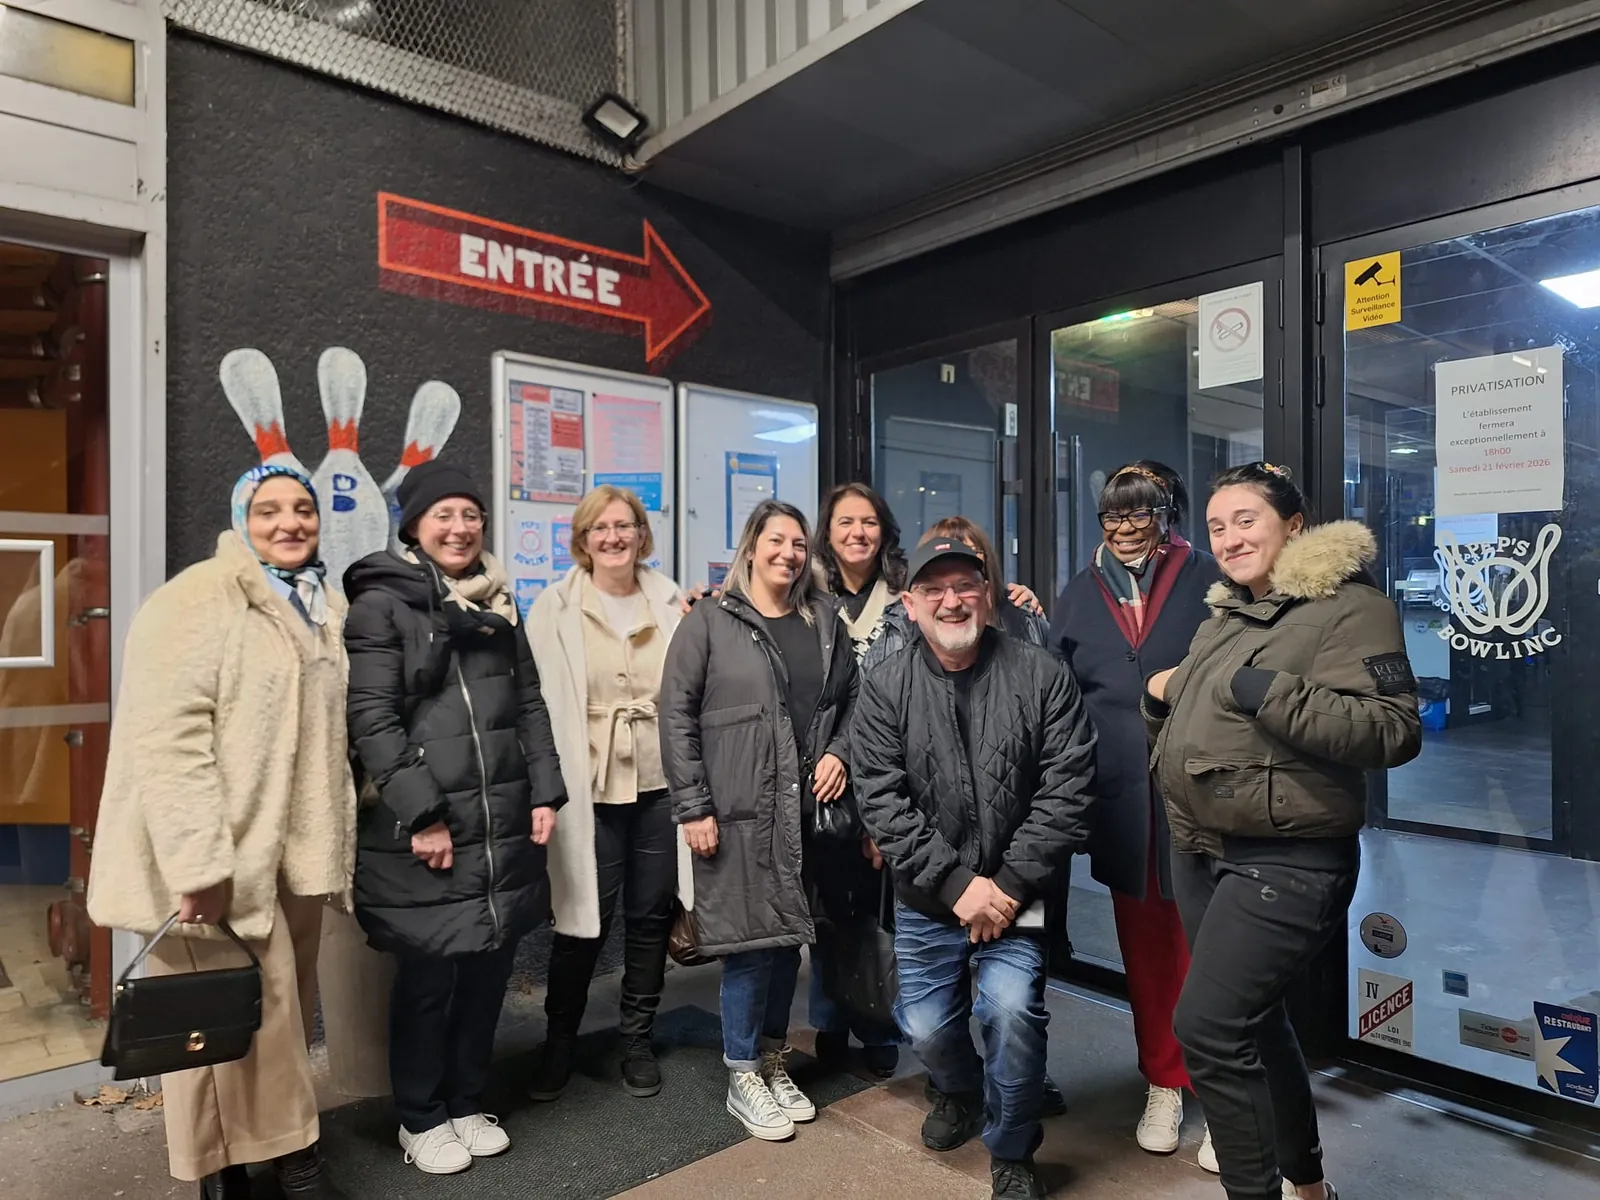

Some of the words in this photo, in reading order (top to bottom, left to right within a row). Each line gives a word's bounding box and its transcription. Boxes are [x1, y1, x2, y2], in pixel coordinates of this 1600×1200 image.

[459, 233, 621, 306] ENTRÉE
[1356, 293, 1390, 304] Attention
[1350, 302, 1396, 315] Surveillance
[1362, 313, 1384, 322] Vidéo
[1451, 374, 1545, 396] PRIVATISATION
[1462, 404, 1532, 419] L'établissement
[1479, 420, 1515, 430] fermera
[1449, 431, 1538, 446] exceptionnellement
[1540, 429, 1546, 438] à
[1484, 447, 1512, 456] 18h00
[1448, 464, 1480, 474] Samedi
[1482, 463, 1493, 471] 21
[1495, 461, 1525, 470] février
[1527, 458, 1551, 468] 2026
[1366, 981, 1379, 999] IV
[1361, 987, 1410, 1034] LICENCE
[1387, 1025, 1399, 1034] LOI
[1543, 1015, 1592, 1032] RESTAURANT
